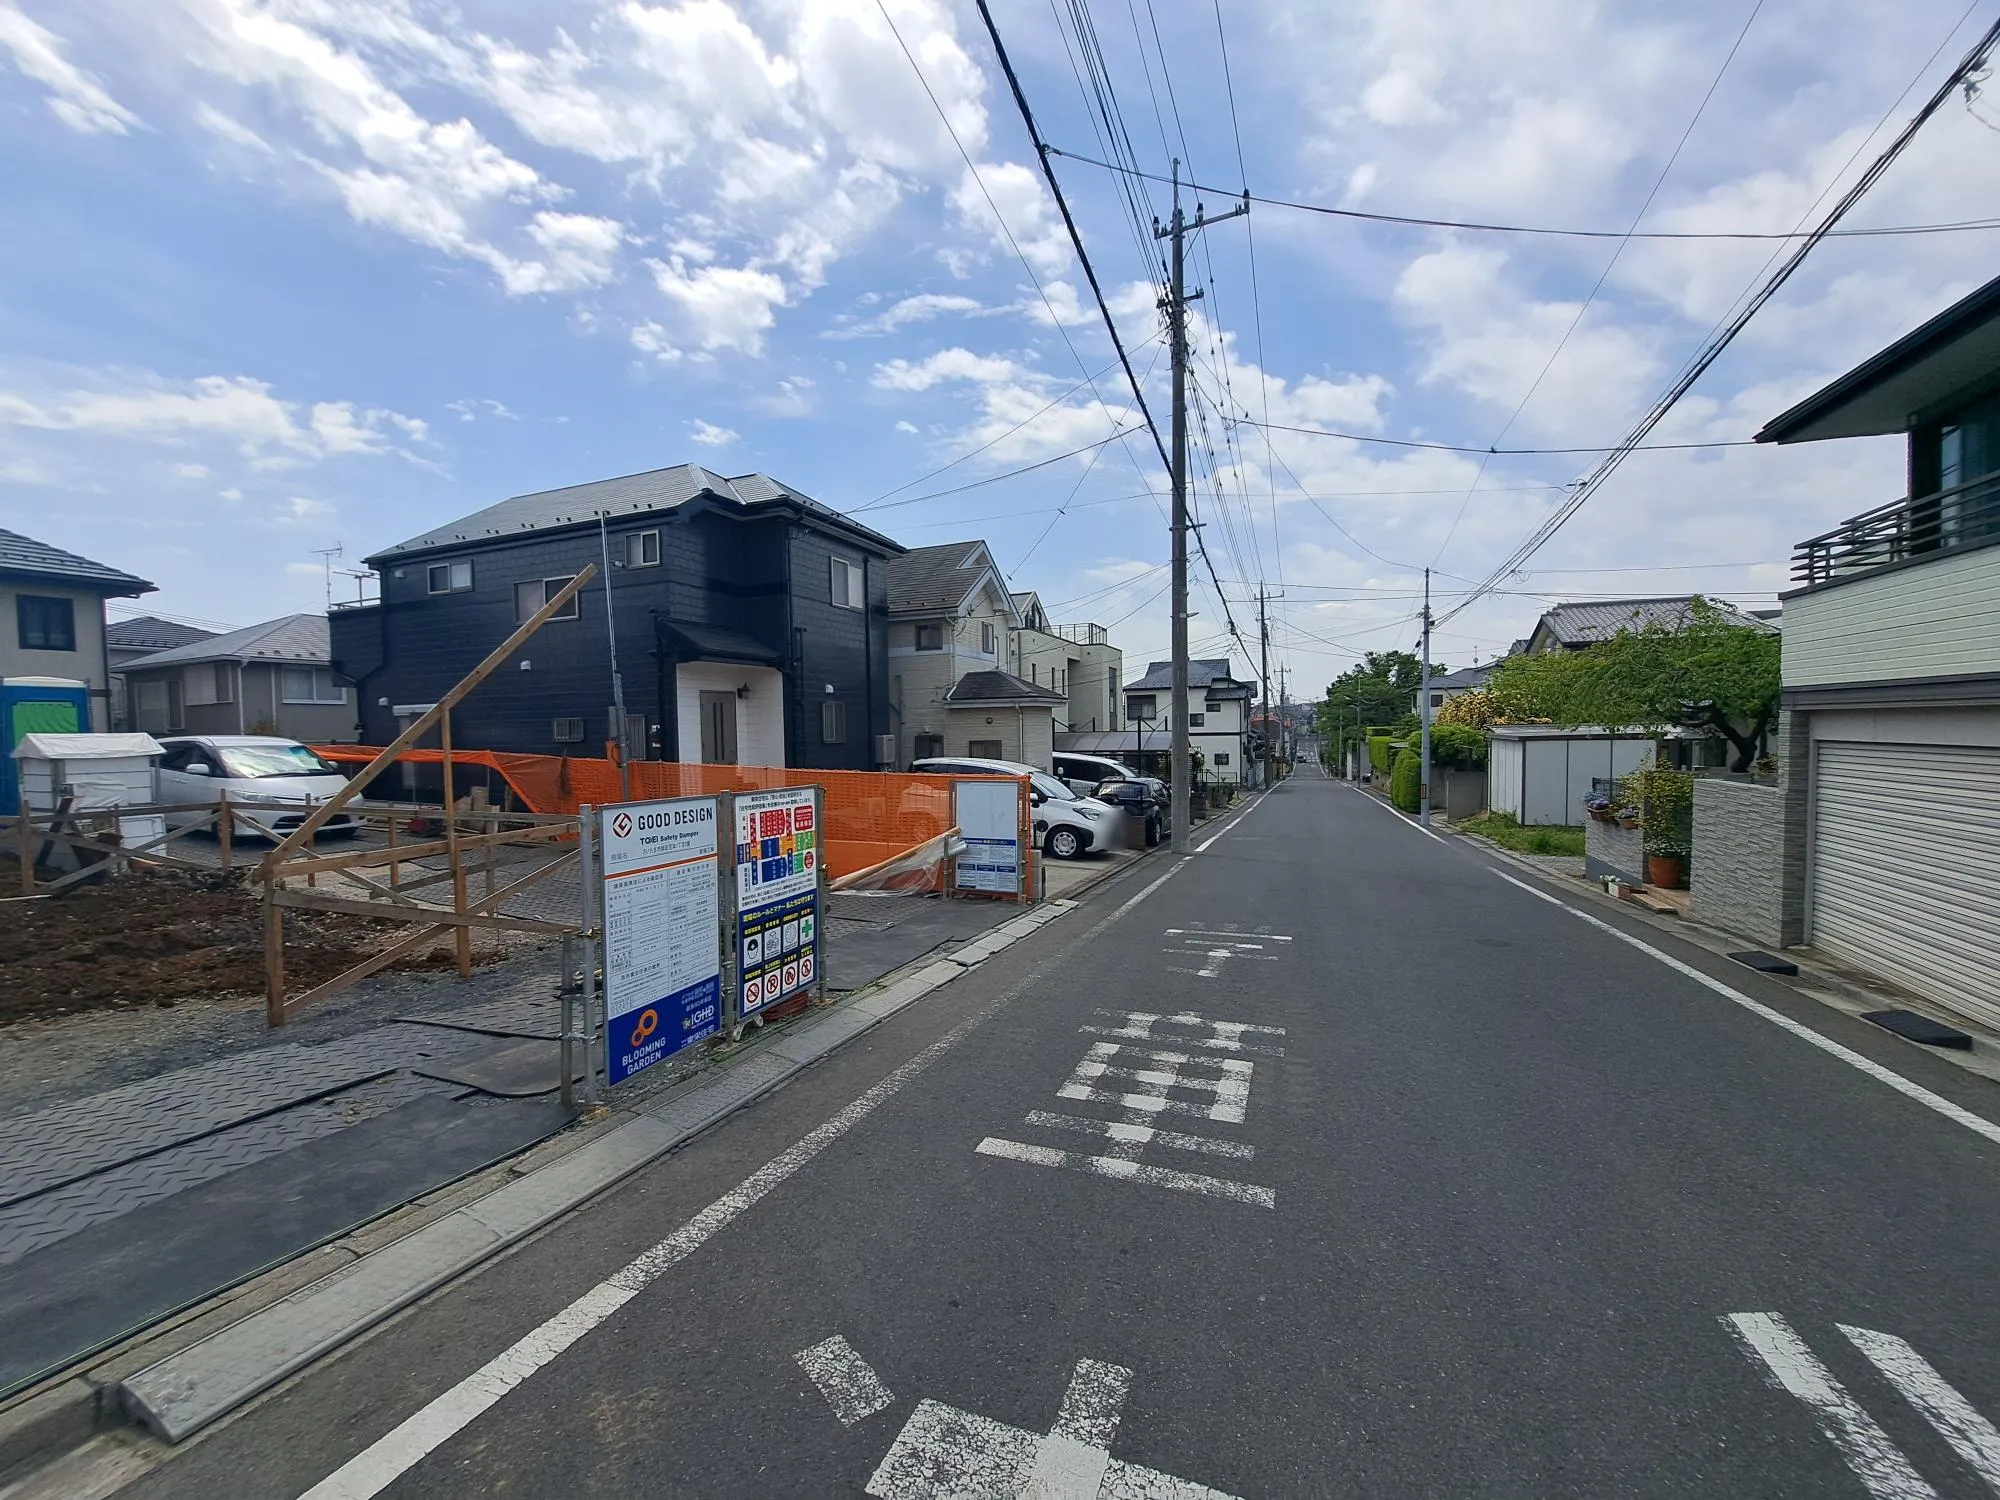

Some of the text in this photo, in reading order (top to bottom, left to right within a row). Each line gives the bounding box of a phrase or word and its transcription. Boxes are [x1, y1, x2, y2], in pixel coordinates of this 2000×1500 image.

[638, 807, 713, 831] GOOD DESIGN
[660, 834, 678, 842] Safety
[679, 831, 699, 839] Damper
[622, 1036, 666, 1066] BLOOMING
[627, 1050, 662, 1075] GARDEN
